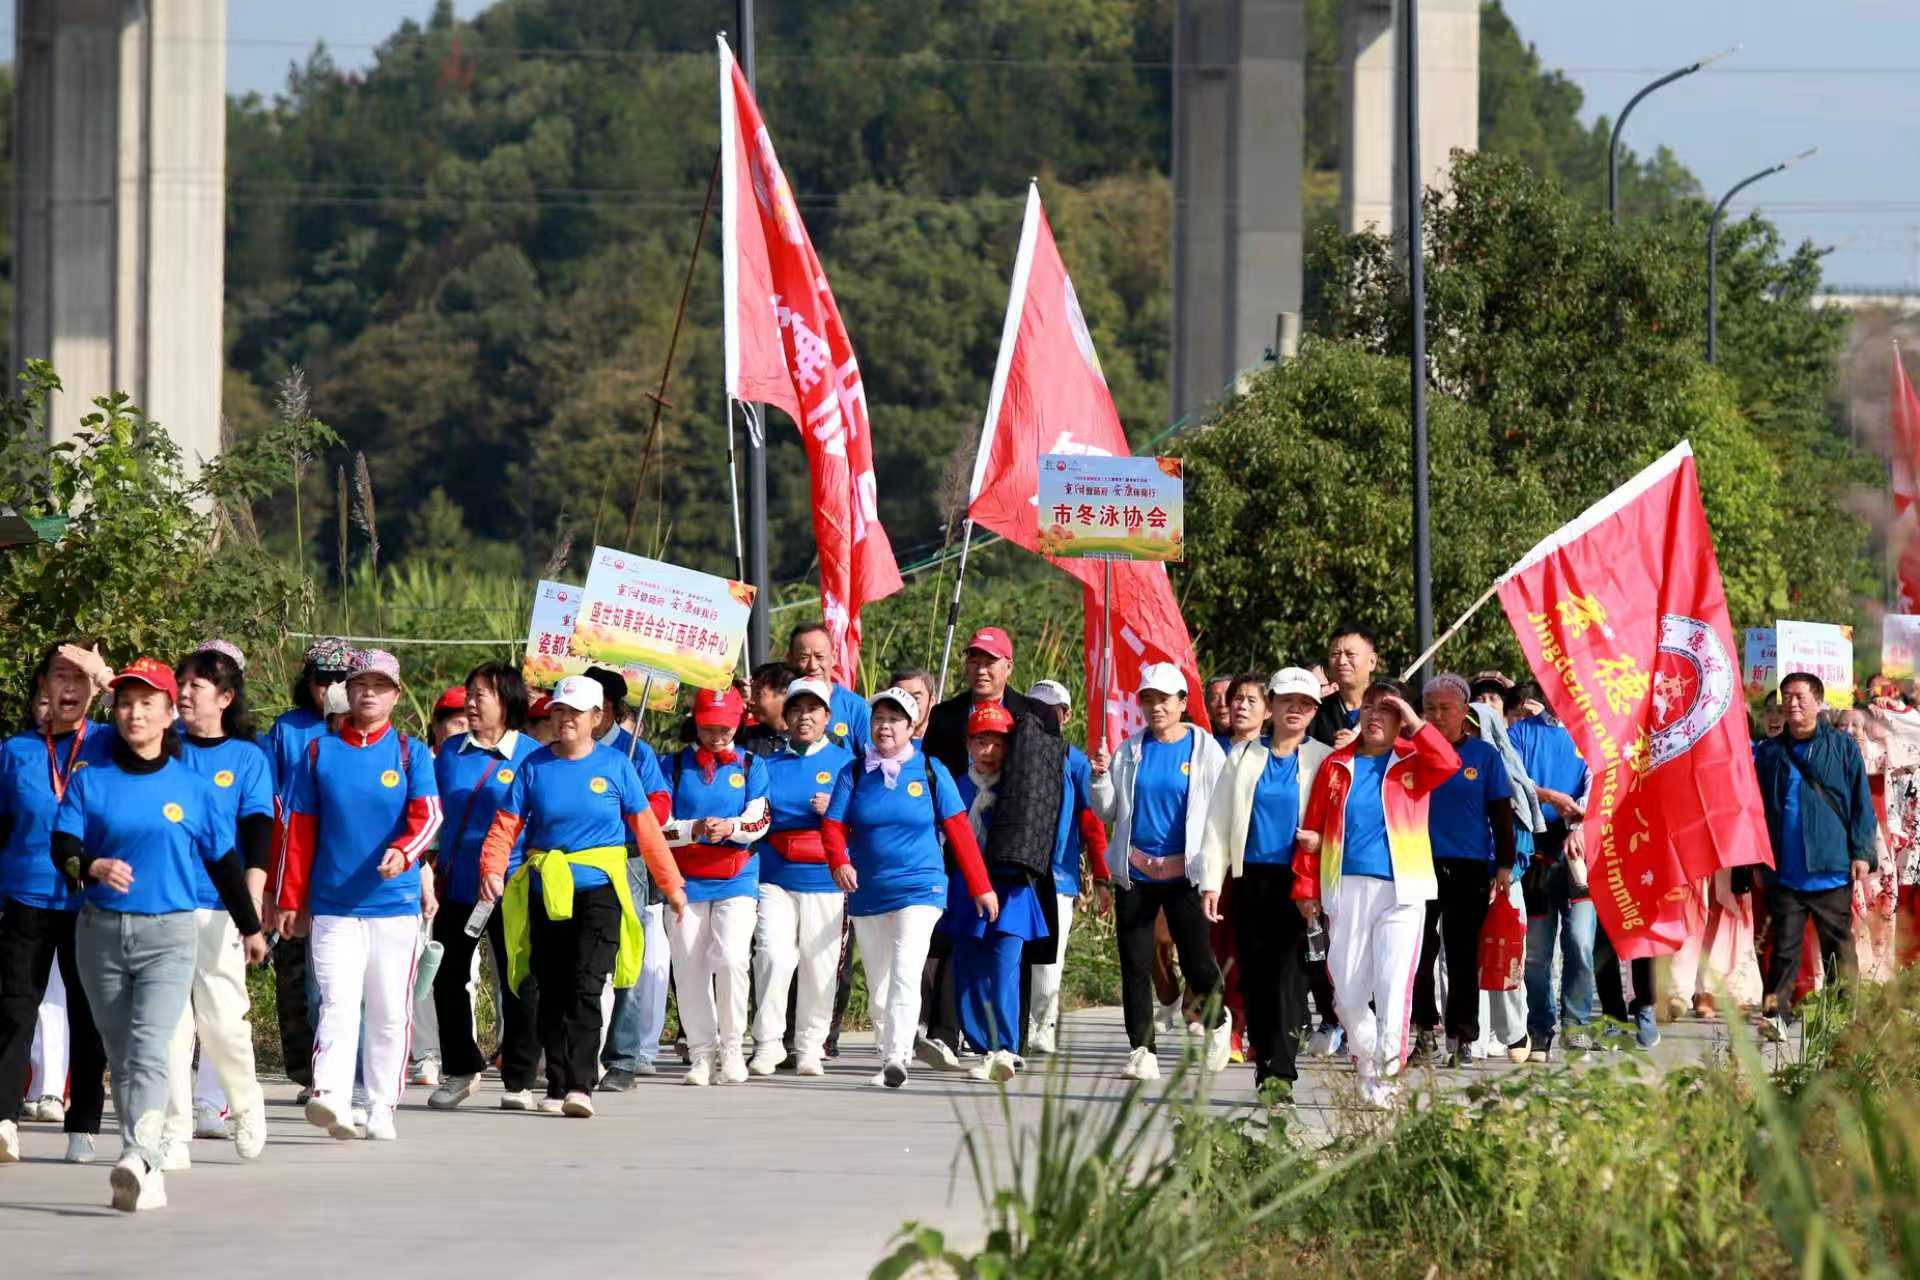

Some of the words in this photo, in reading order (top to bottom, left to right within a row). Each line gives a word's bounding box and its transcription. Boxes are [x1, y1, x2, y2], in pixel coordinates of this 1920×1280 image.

[1053, 503, 1167, 528] 市冬泳协会
